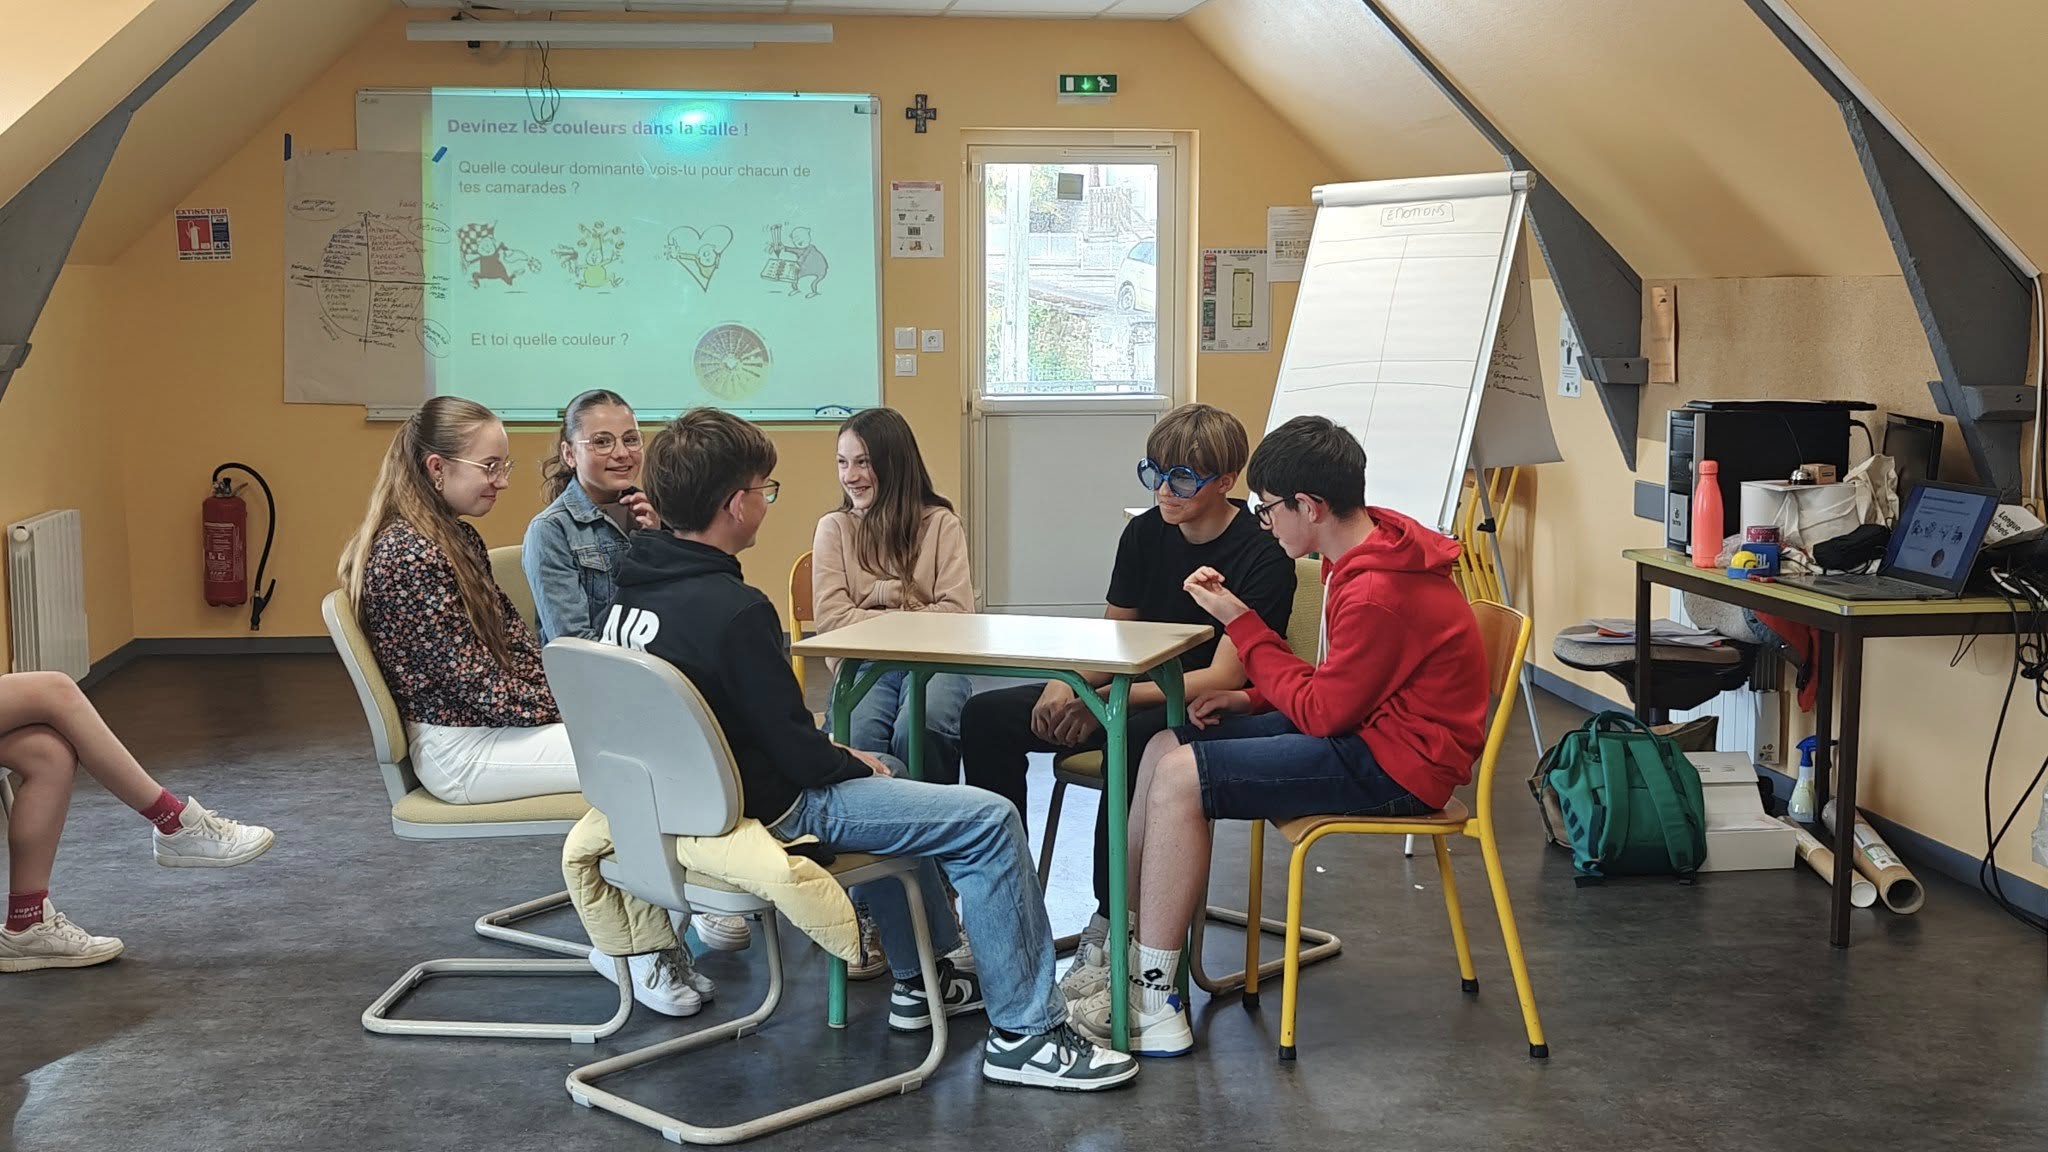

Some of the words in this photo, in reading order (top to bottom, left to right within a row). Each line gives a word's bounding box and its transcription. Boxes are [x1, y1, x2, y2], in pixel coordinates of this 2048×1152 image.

[447, 118, 518, 134] Devinez
[523, 119, 547, 135] les
[552, 119, 627, 135] couleurs
[632, 121, 673, 135] dans
[679, 121, 693, 135] la
[700, 122, 738, 136] salle
[458, 160, 506, 174] Quelle
[511, 161, 565, 175] couleur
[569, 162, 645, 176] dominante
[649, 163, 696, 177] vois-tu
[701, 165, 733, 180] pour
[737, 164, 789, 177] chacun
[793, 165, 811, 178] de
[458, 181, 481, 193] tes
[485, 181, 567, 194] camarades
[571, 180, 580, 194] ?
[470, 332, 487, 346] Et
[490, 332, 509, 346] toi
[513, 332, 557, 349] quelle
[561, 333, 616, 346] couleur
[620, 332, 629, 346] ?
[1755, 553, 1770, 568] BL
[599, 604, 660, 653] AIR
